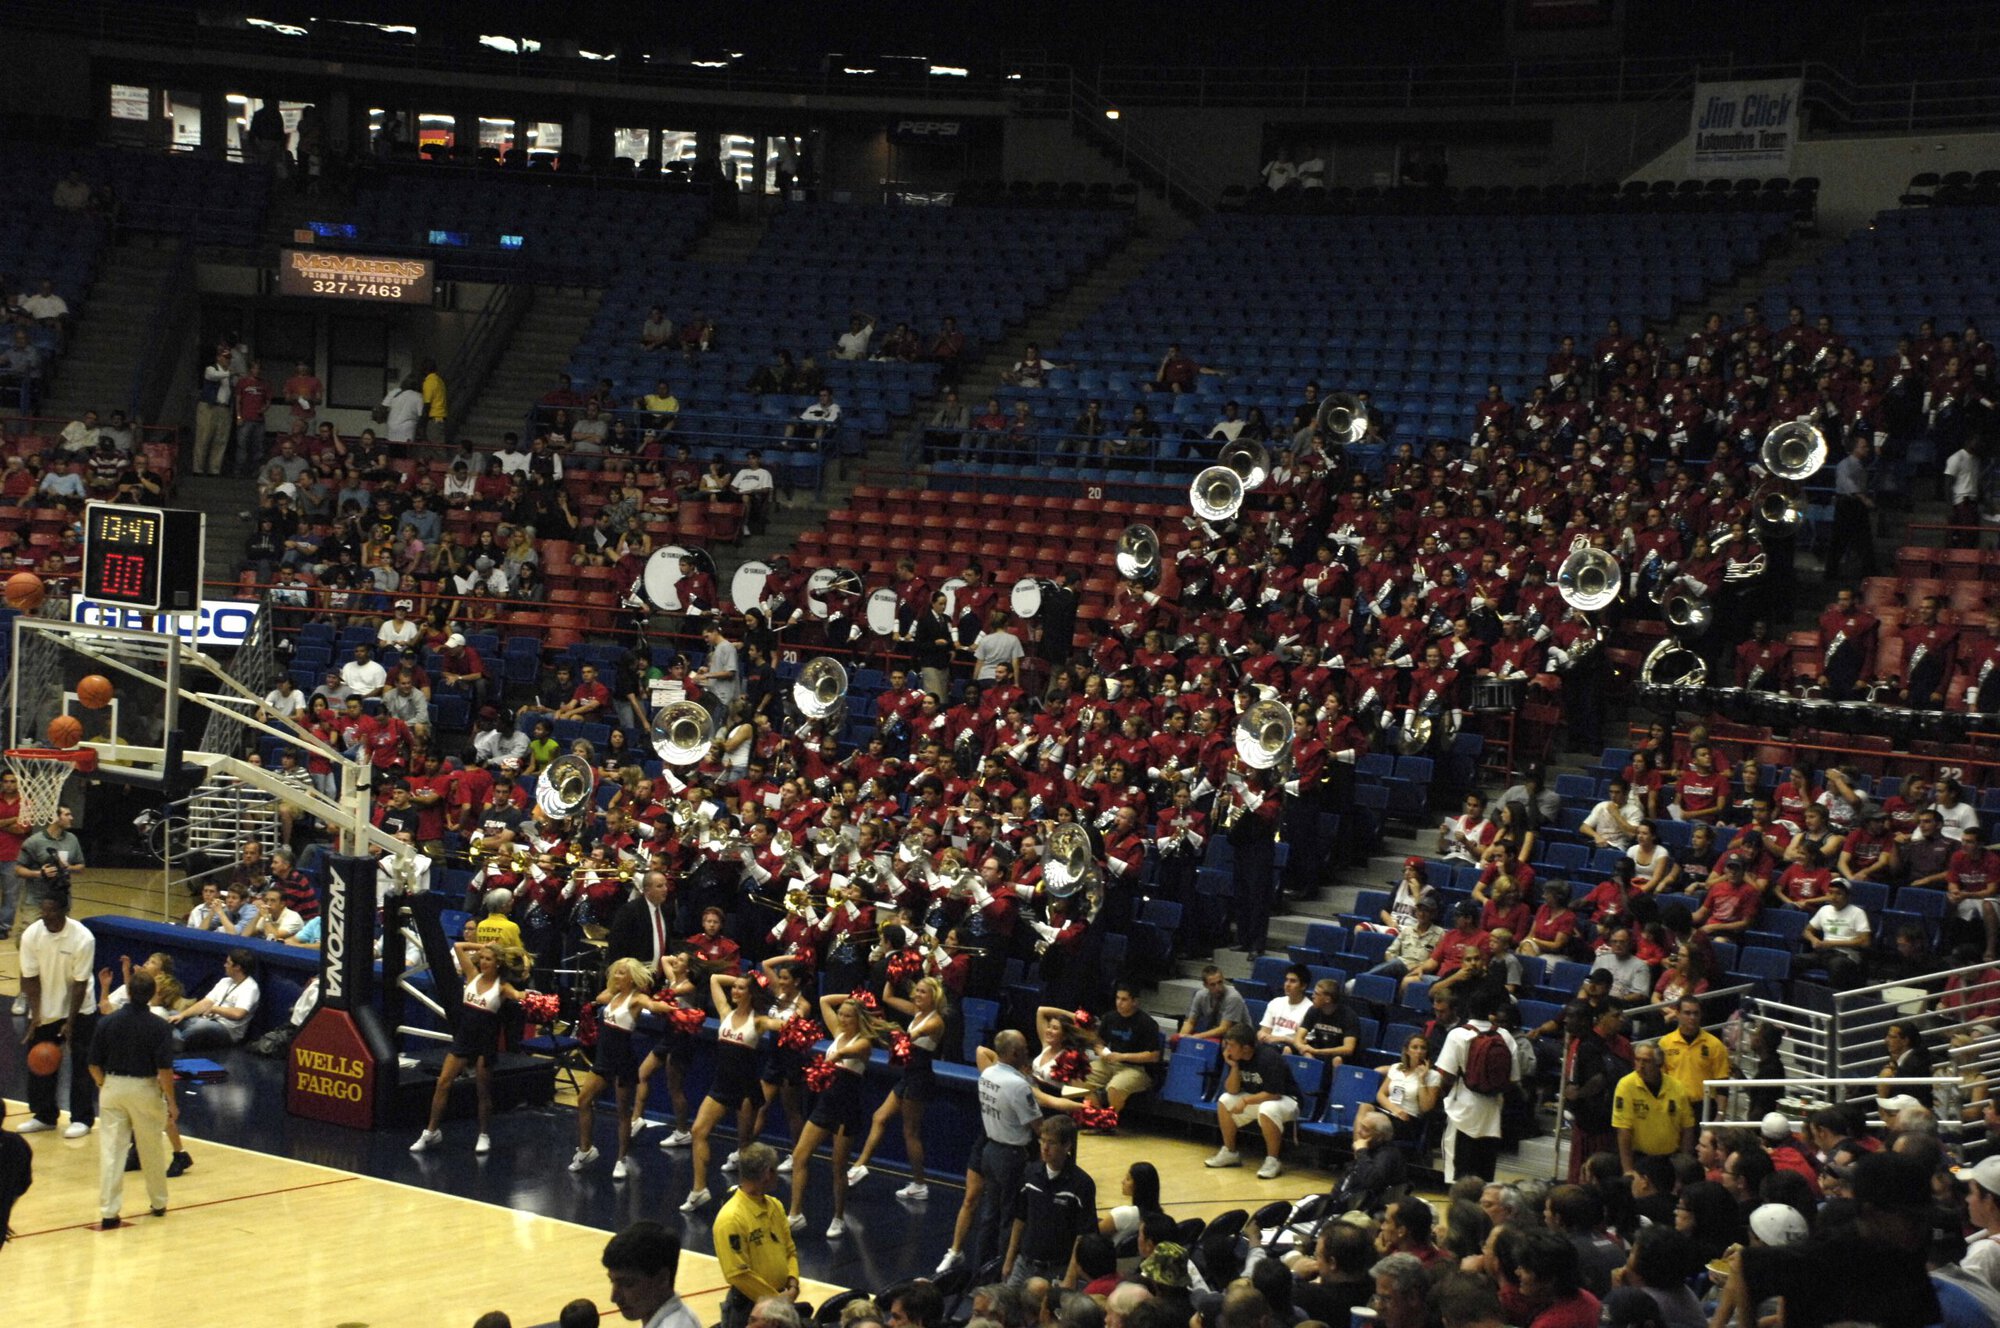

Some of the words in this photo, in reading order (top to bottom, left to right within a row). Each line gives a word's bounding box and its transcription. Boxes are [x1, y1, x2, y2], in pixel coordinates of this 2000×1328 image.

[1699, 96, 1735, 129] Jim
[1742, 93, 1791, 127] Click
[897, 121, 960, 135] PEPSI
[1696, 132, 1754, 150] Automotive
[1758, 129, 1787, 149] Team
[302, 271, 335, 279] PRIME
[342, 274, 414, 286] STEAKHOUSE
[313, 280, 402, 298] 327-7463
[1088, 486, 1102, 500] 20
[101, 515, 155, 545] 13:47
[101, 553, 145, 596] 00
[76, 601, 257, 639] GEICO
[782, 650, 798, 665] 20
[1940, 766, 1963, 780] 22
[325, 866, 346, 997] ARIZONA
[296, 1048, 365, 1079] WELLS
[297, 1072, 363, 1102] FARGO
